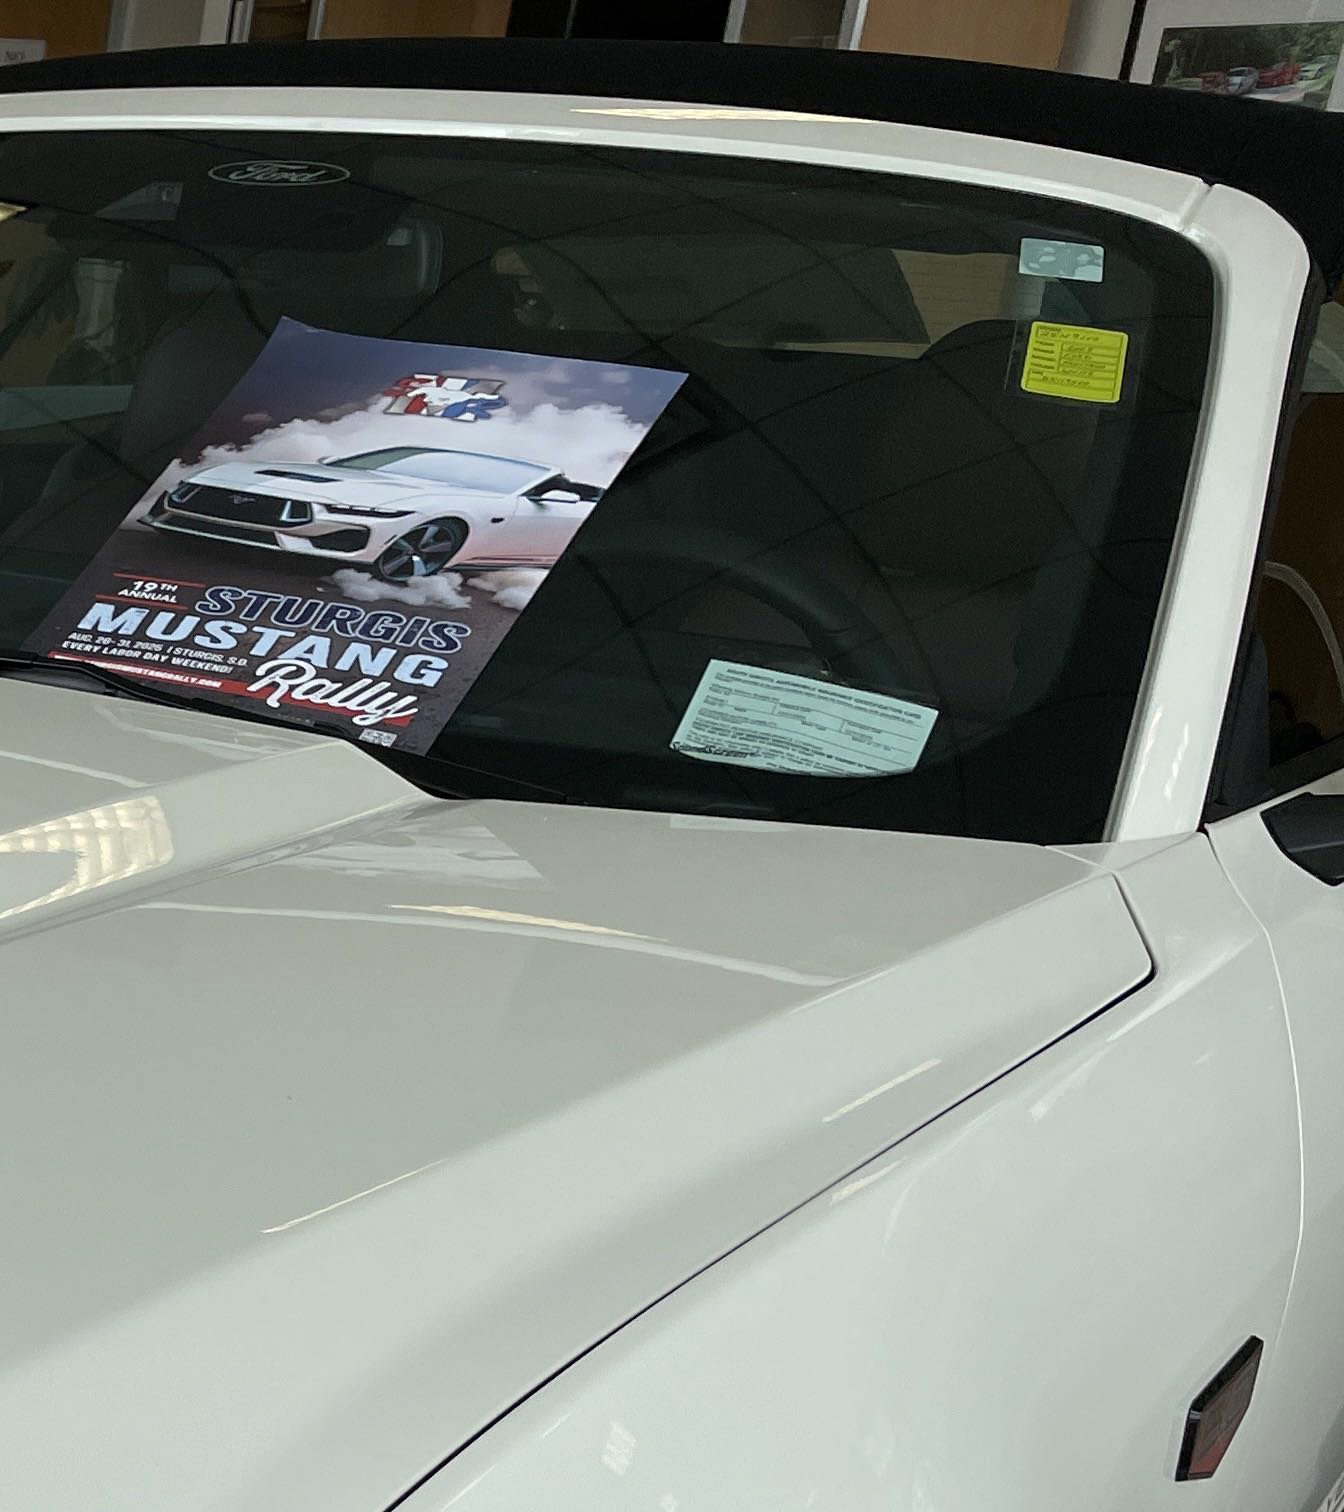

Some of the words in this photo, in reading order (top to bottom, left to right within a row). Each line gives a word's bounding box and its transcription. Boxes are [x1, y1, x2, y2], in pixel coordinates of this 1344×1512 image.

[228, 163, 326, 181] Ford
[117, 588, 178, 604] ANNUAL
[132, 580, 178, 592] 19TH
[195, 585, 471, 654] STURGIS
[61, 640, 102, 653] EVERY
[102, 646, 142, 659] LABOR
[142, 651, 169, 663] DAY
[171, 656, 234, 674] WEEKEND!
[77, 601, 449, 689] MUSTANG
[247, 659, 419, 727] Rally
